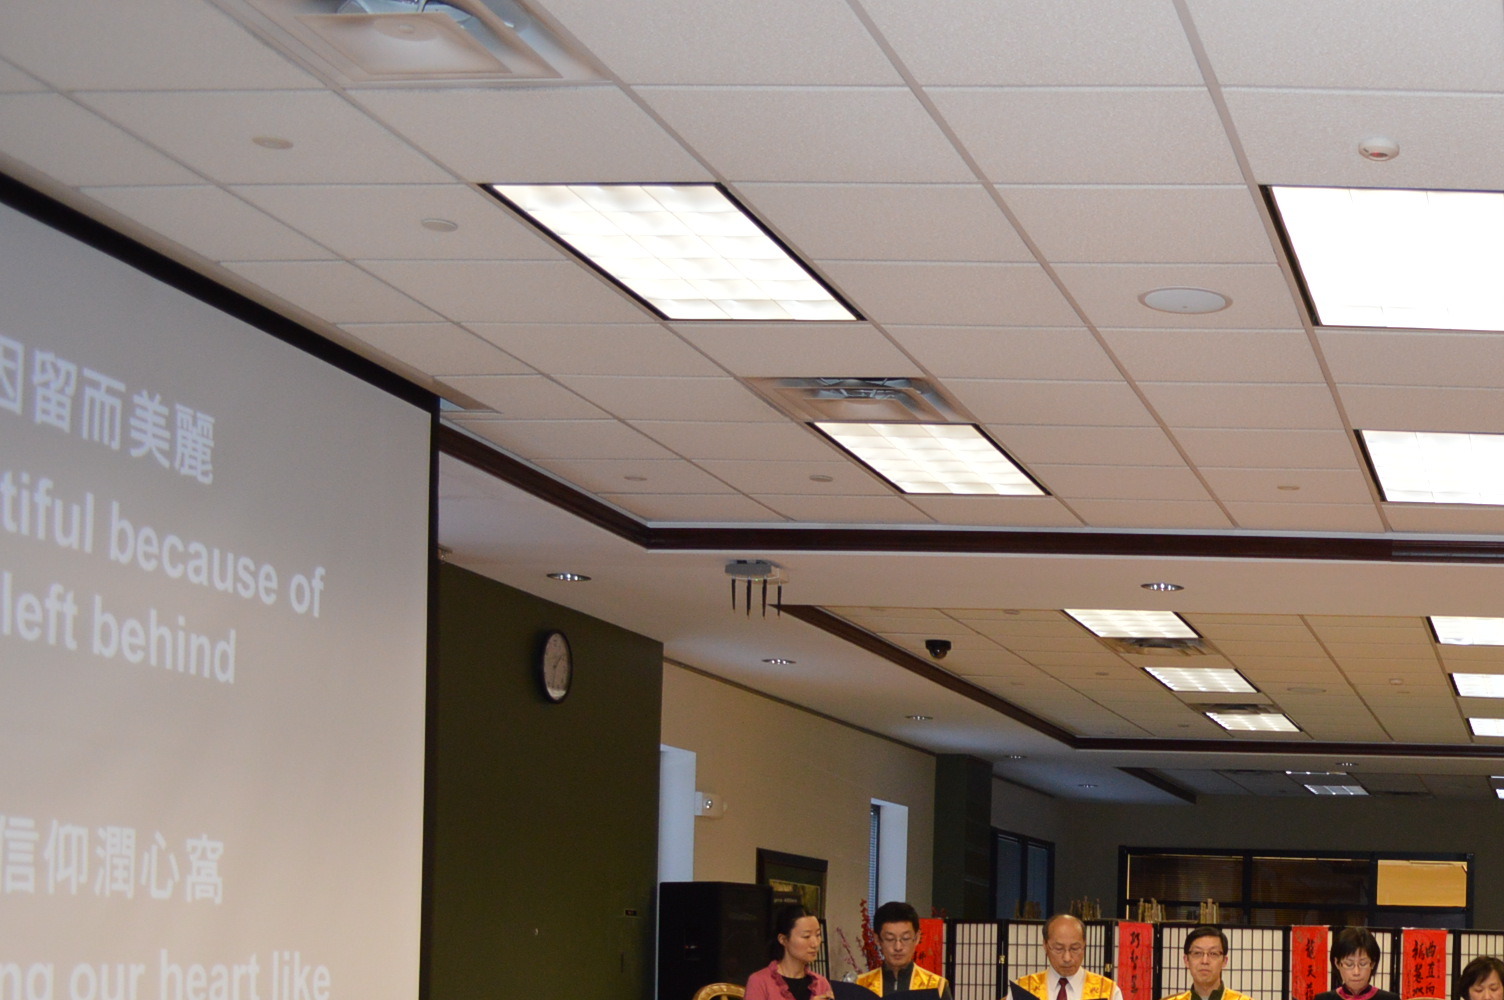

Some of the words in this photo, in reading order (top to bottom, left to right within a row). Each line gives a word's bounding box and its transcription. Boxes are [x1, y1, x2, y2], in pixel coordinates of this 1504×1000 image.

[110, 501, 279, 605] because
[289, 566, 326, 618] of
[0, 570, 79, 650] left
[93, 595, 237, 684] behind
